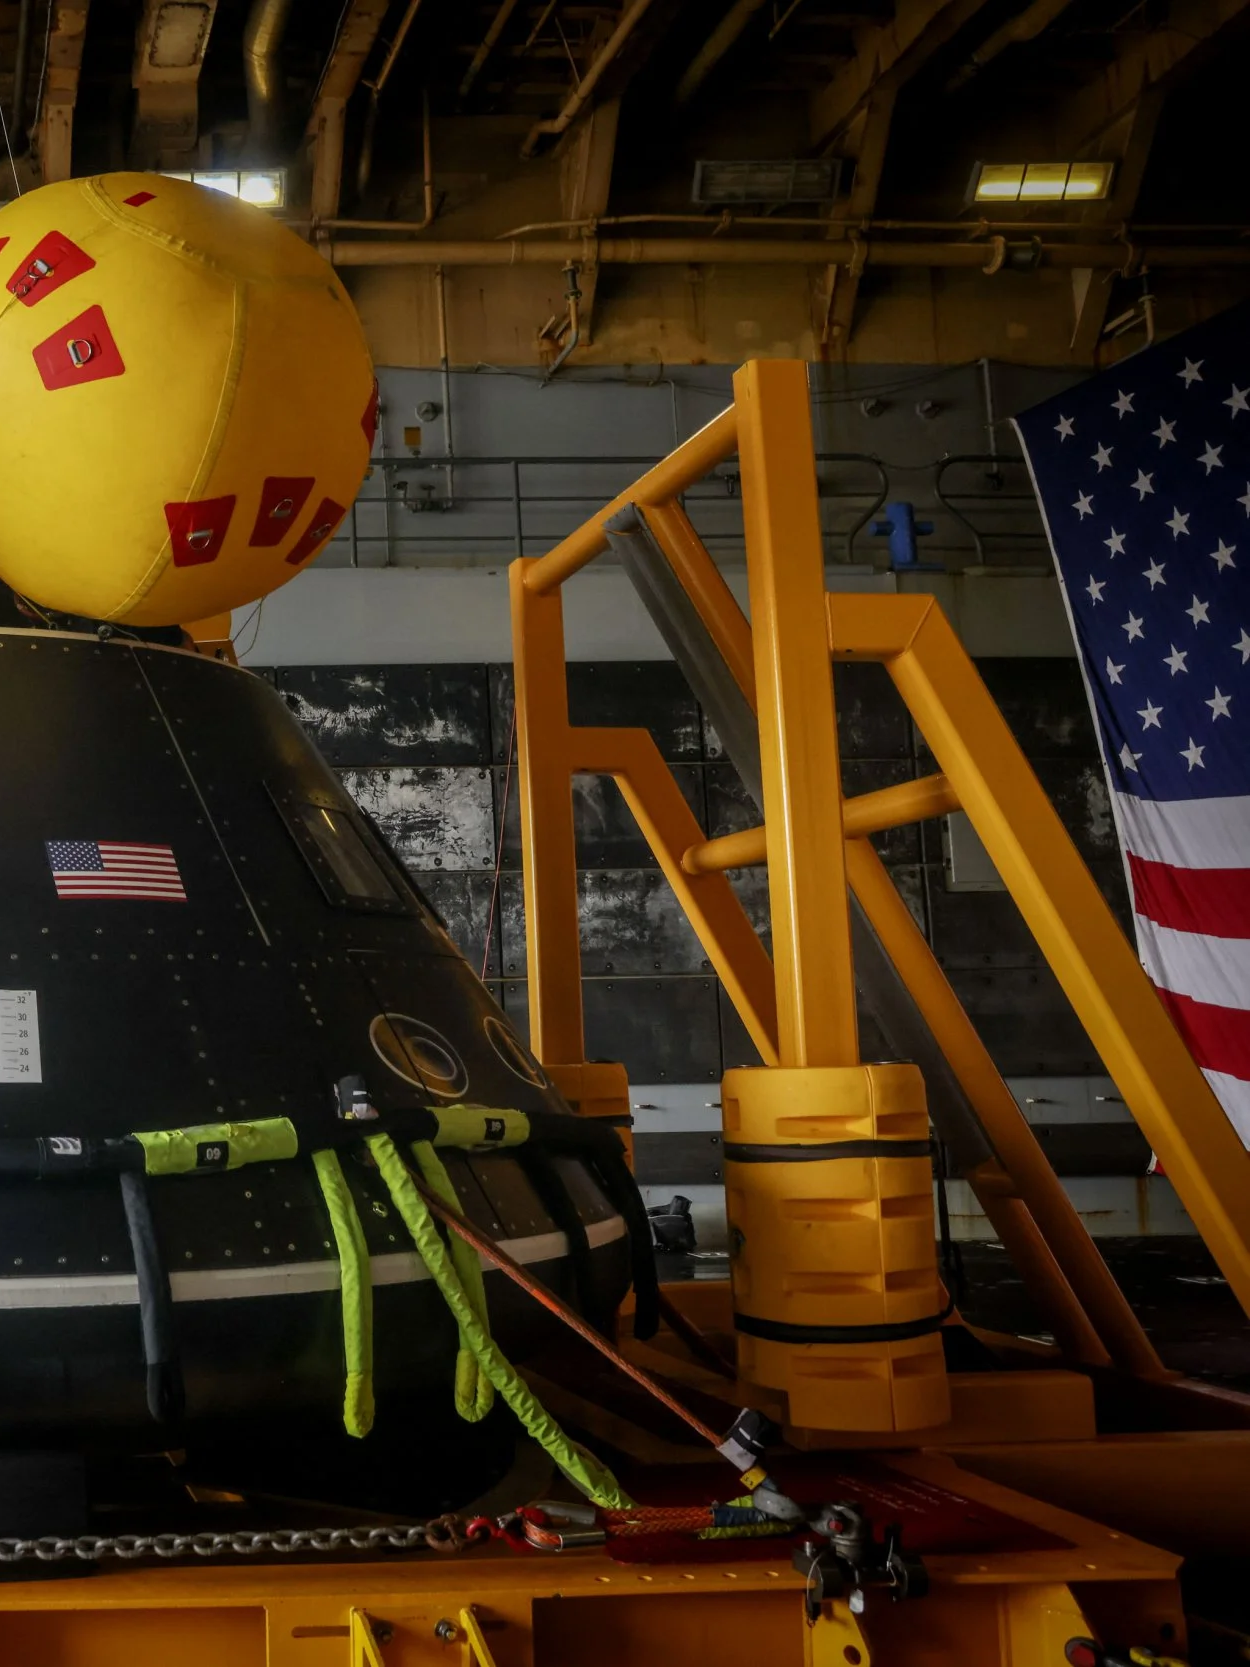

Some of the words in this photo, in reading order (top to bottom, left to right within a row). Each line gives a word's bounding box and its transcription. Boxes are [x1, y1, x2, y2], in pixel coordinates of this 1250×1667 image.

[17, 996, 26, 1004] 32
[17, 1013, 27, 1021] 30
[18, 1029, 28, 1038] 28
[19, 1047, 29, 1056] 26
[19, 1064, 30, 1073] 24
